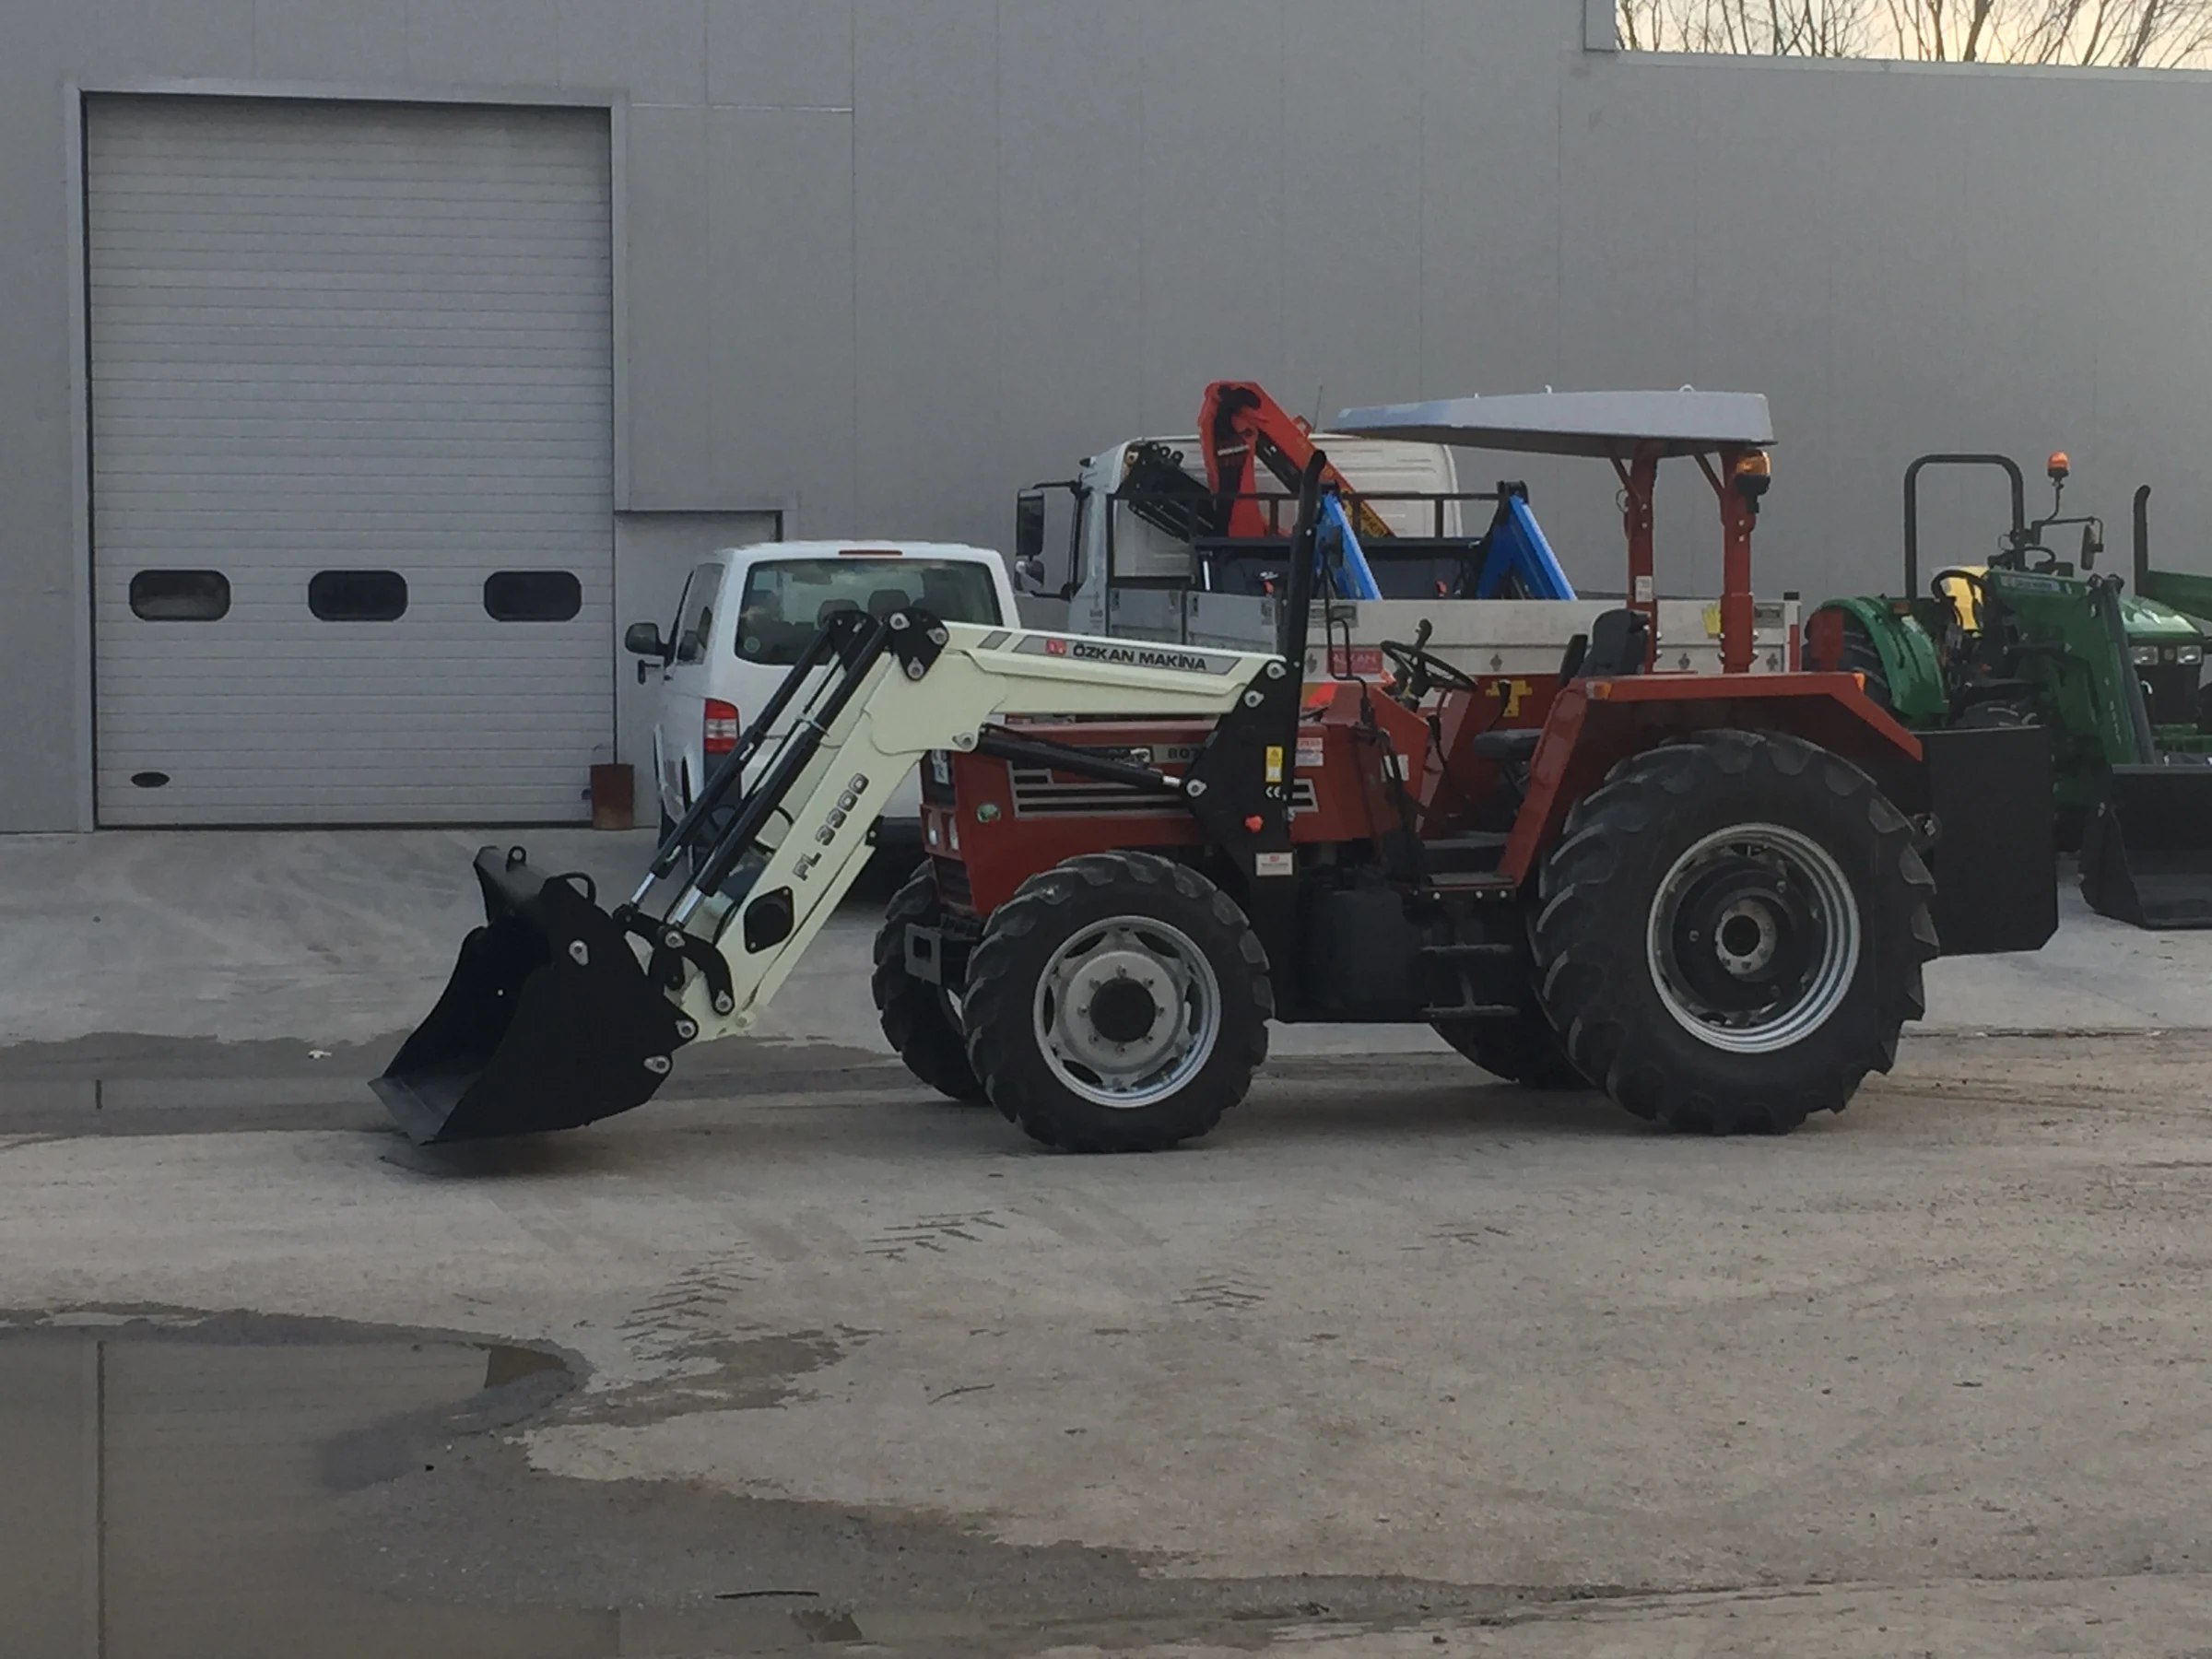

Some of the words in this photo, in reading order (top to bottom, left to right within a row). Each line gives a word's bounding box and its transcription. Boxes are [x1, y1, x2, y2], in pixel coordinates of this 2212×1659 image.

[1073, 643, 1134, 663] ÖZKAN
[1139, 652, 1207, 671] MAKİNA
[815, 772, 870, 846] 3300
